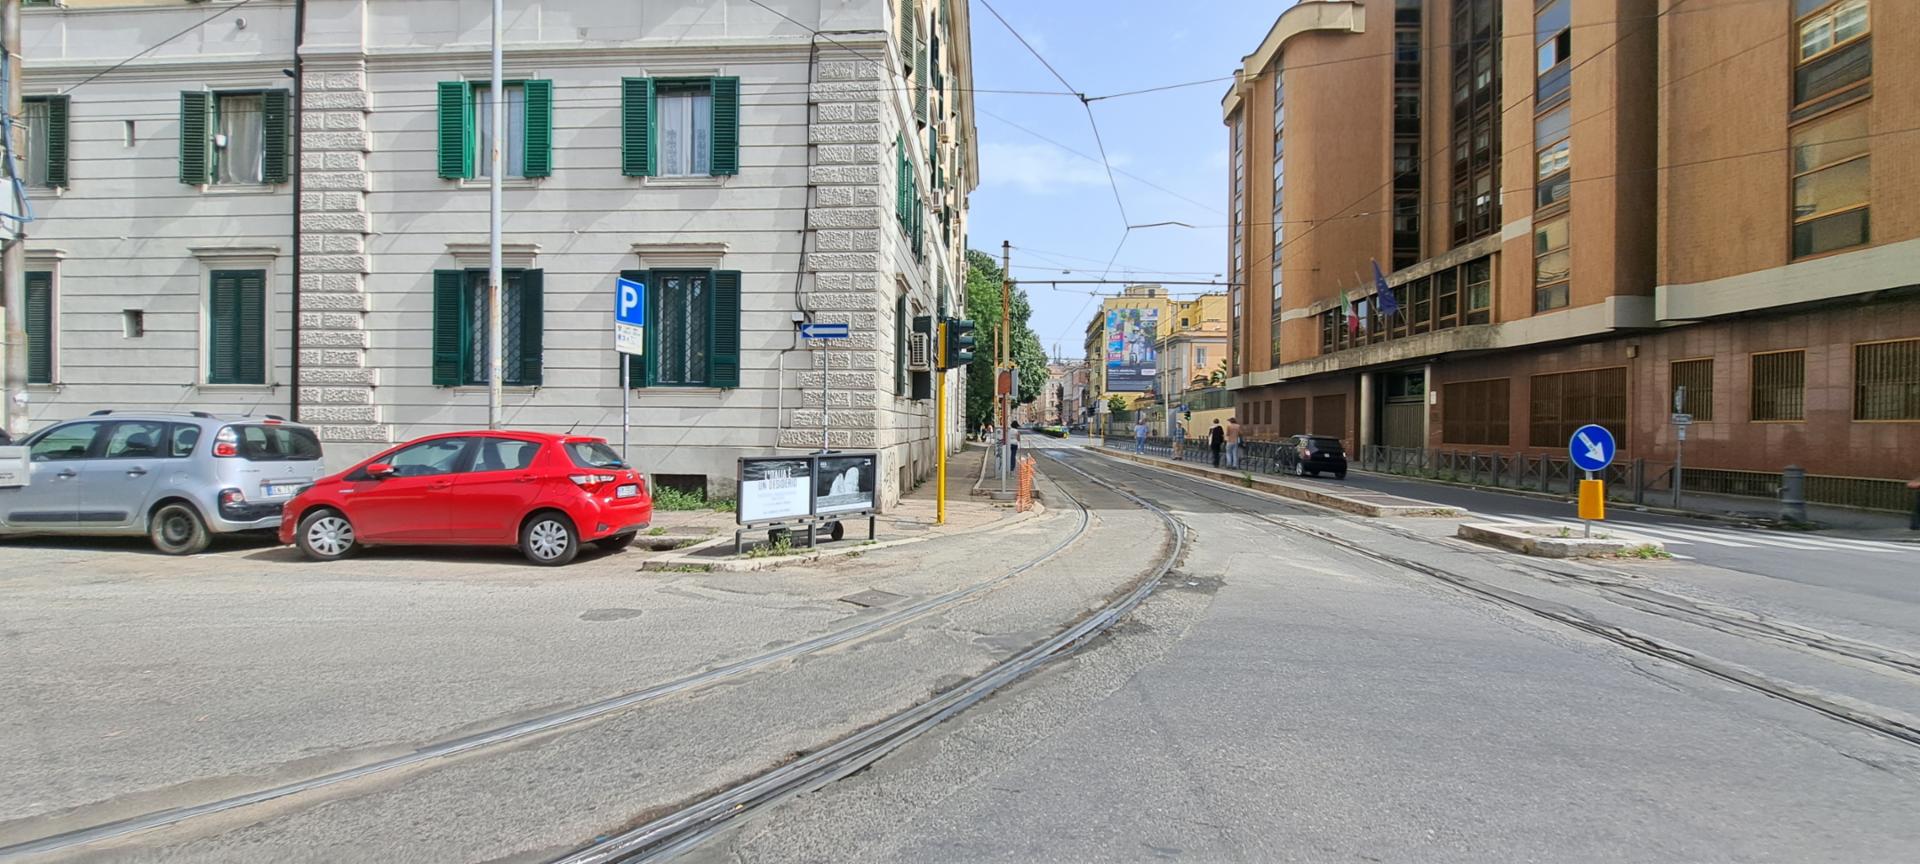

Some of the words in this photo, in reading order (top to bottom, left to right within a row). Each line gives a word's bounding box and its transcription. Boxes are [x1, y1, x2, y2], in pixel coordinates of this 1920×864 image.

[621, 285, 638, 317] P
[758, 481, 767, 490] UN
[769, 478, 798, 490] DESIDERIO
